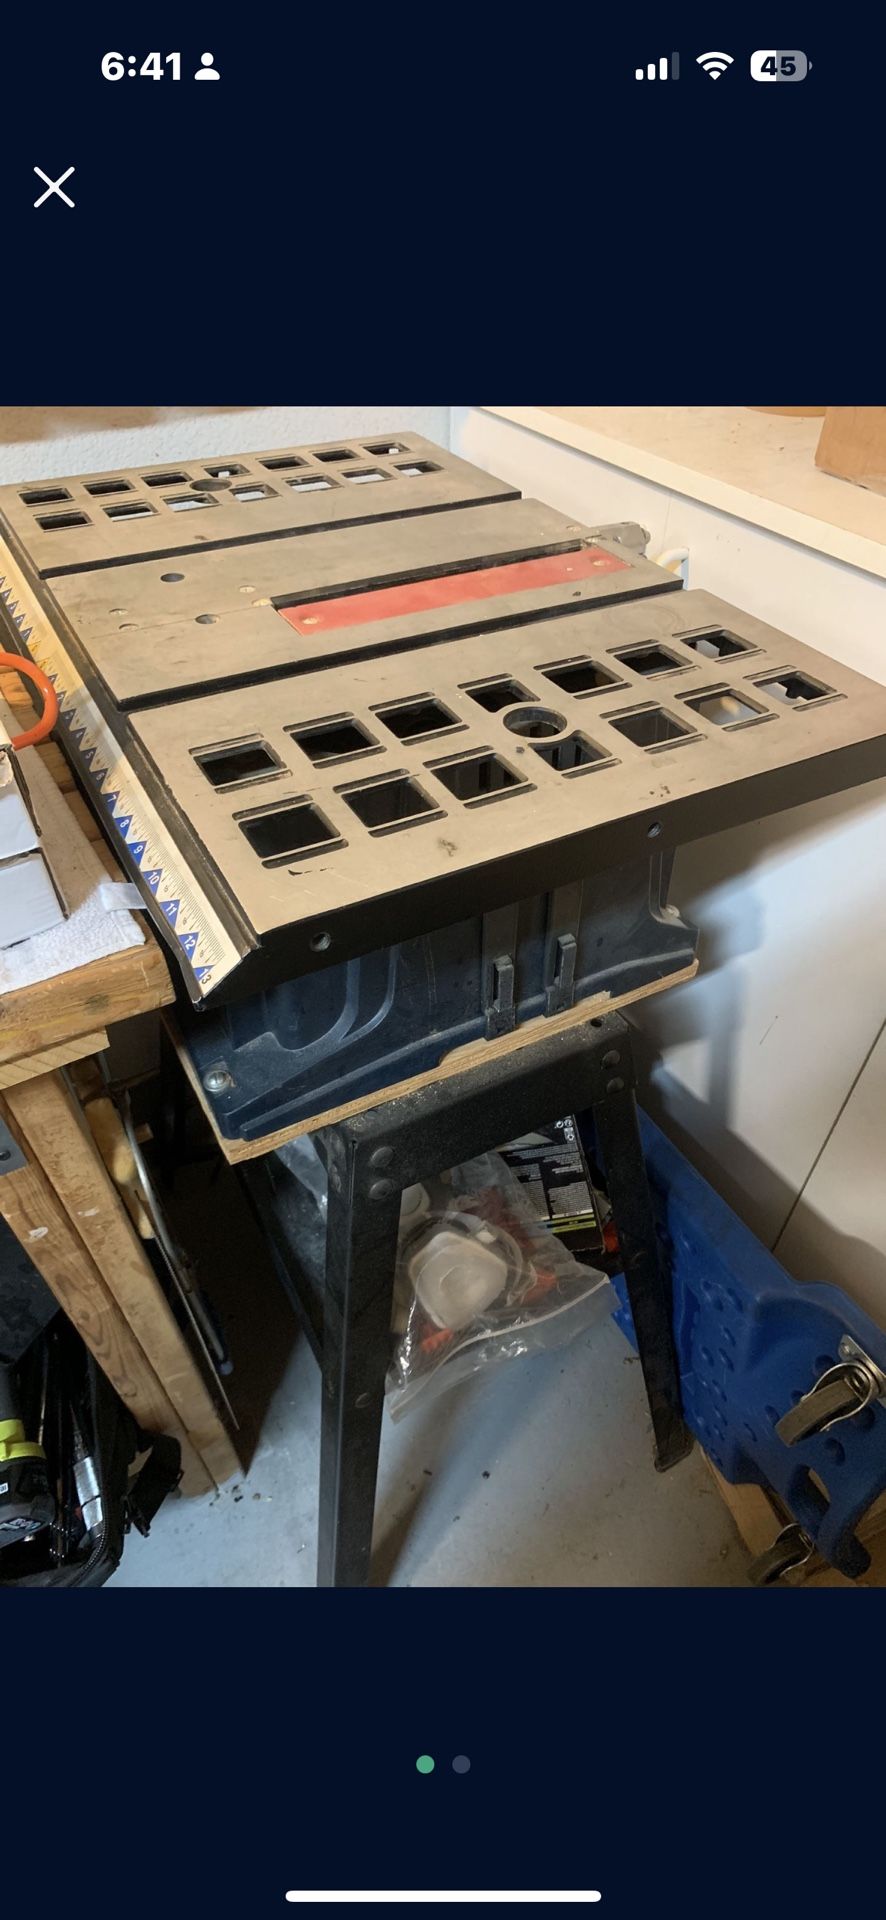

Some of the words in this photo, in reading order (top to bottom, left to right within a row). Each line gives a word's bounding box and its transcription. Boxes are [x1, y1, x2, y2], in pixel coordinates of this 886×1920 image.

[120, 819, 130, 828] 8
[133, 845, 144, 854] 9
[148, 871, 160, 885] 10
[165, 903, 178, 916] 11
[184, 935, 196, 950] 12
[199, 968, 212, 985] 13
